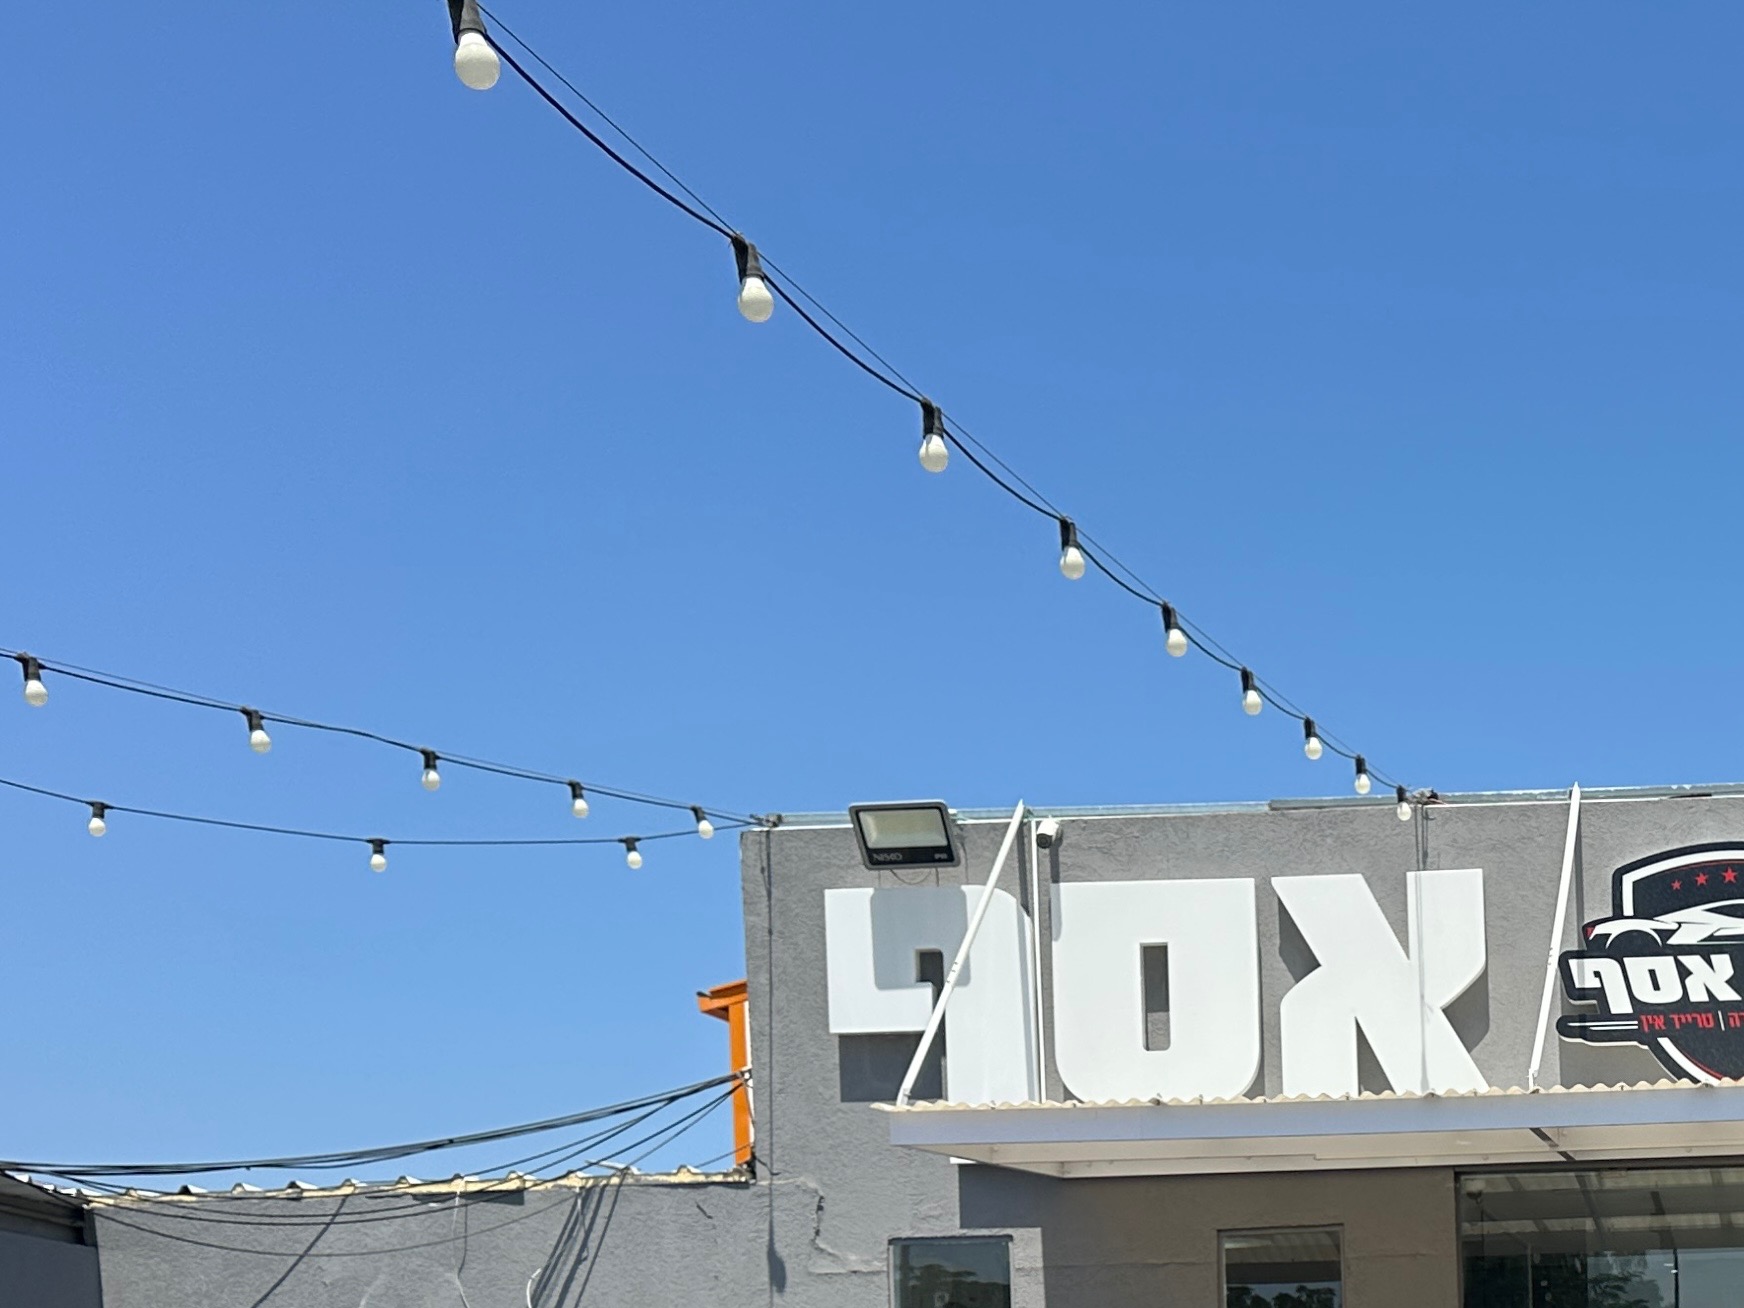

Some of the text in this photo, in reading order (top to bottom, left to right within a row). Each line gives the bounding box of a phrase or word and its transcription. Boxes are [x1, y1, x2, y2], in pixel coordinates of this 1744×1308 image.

[825, 868, 1490, 1103] אסף
[1567, 953, 1743, 1015] אסף
[1639, 1013, 1667, 1033] אין
[1669, 1010, 1715, 1030] טרייד
